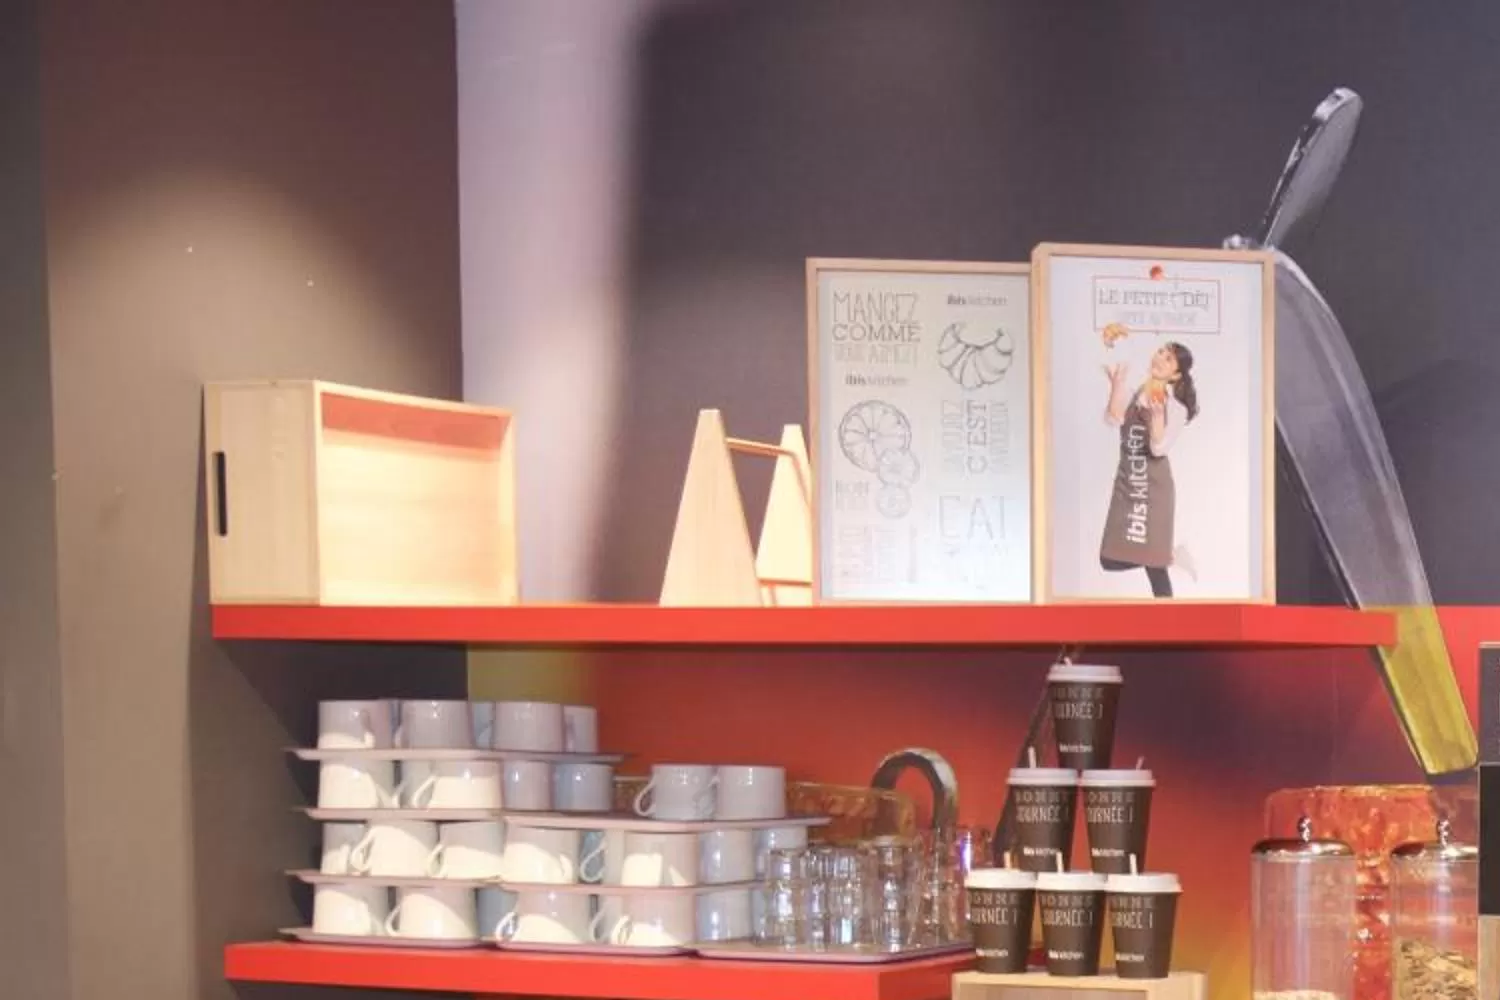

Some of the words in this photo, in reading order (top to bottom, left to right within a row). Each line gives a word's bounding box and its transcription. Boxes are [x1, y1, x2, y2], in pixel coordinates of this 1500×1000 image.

[832, 291, 919, 323] MANGEZ
[832, 323, 921, 342] COMME
[1128, 423, 1149, 499] kitchen
[1126, 503, 1148, 544] ibis
